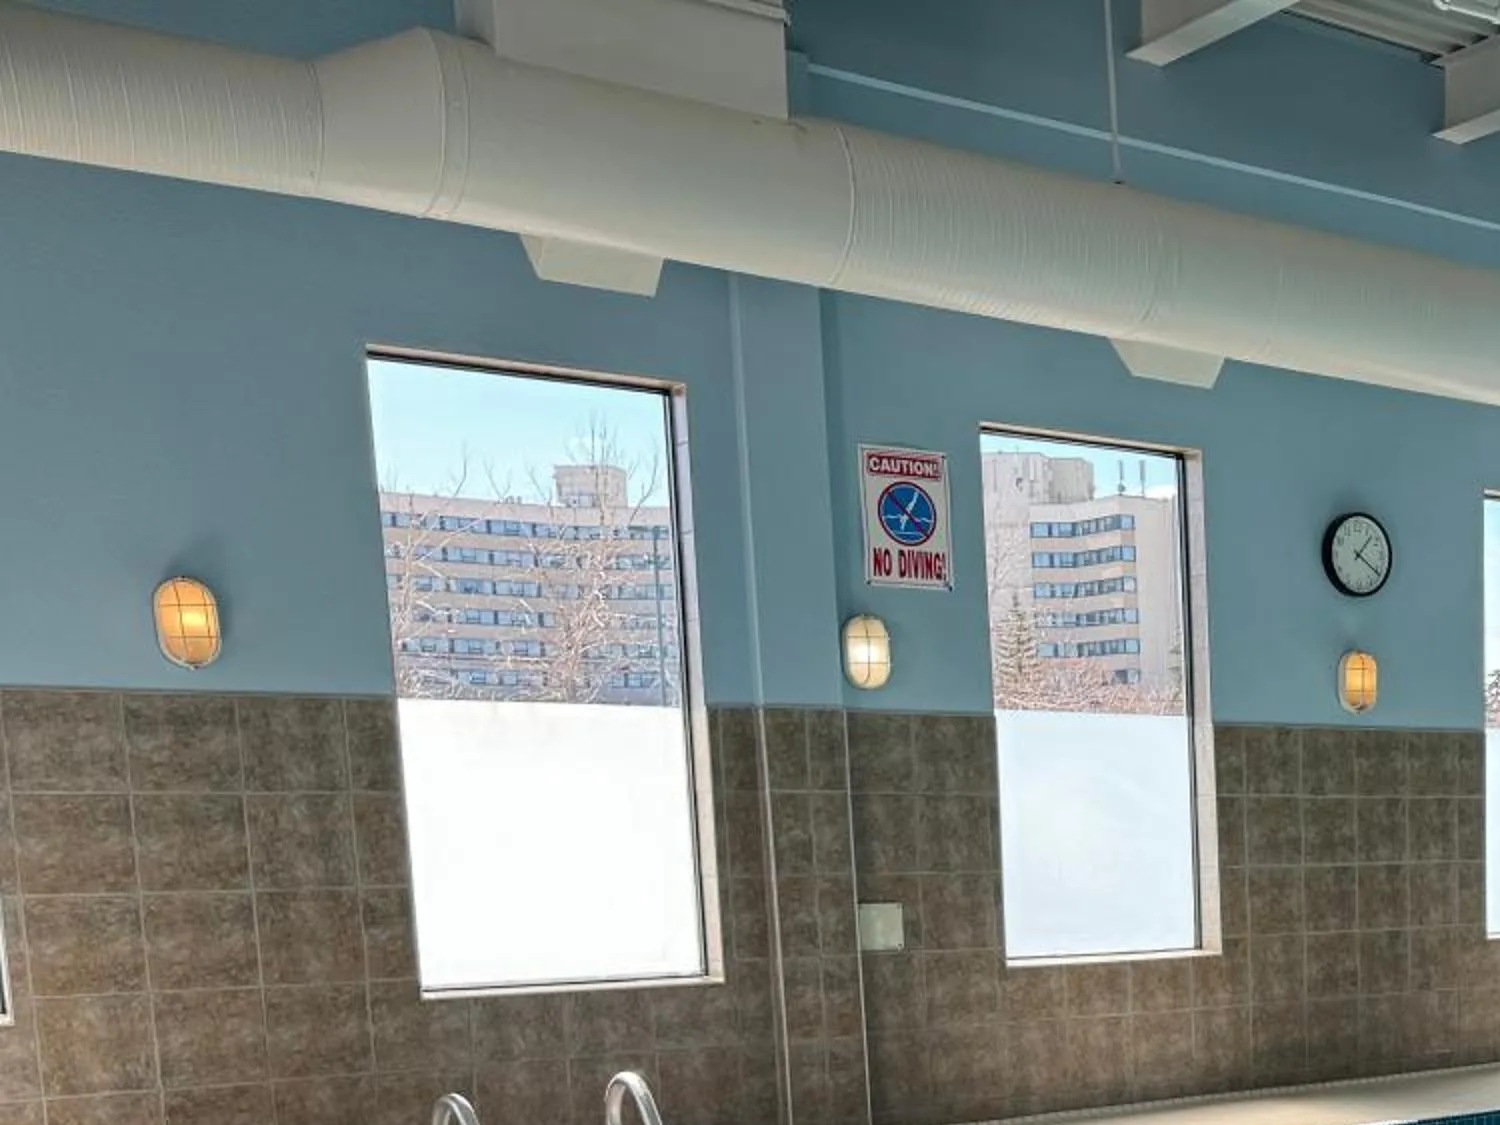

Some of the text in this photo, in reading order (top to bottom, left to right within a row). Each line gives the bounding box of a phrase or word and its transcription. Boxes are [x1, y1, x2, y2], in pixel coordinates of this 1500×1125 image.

[869, 456, 938, 476] CAUTION!
[873, 548, 947, 581] NO DIVING!
